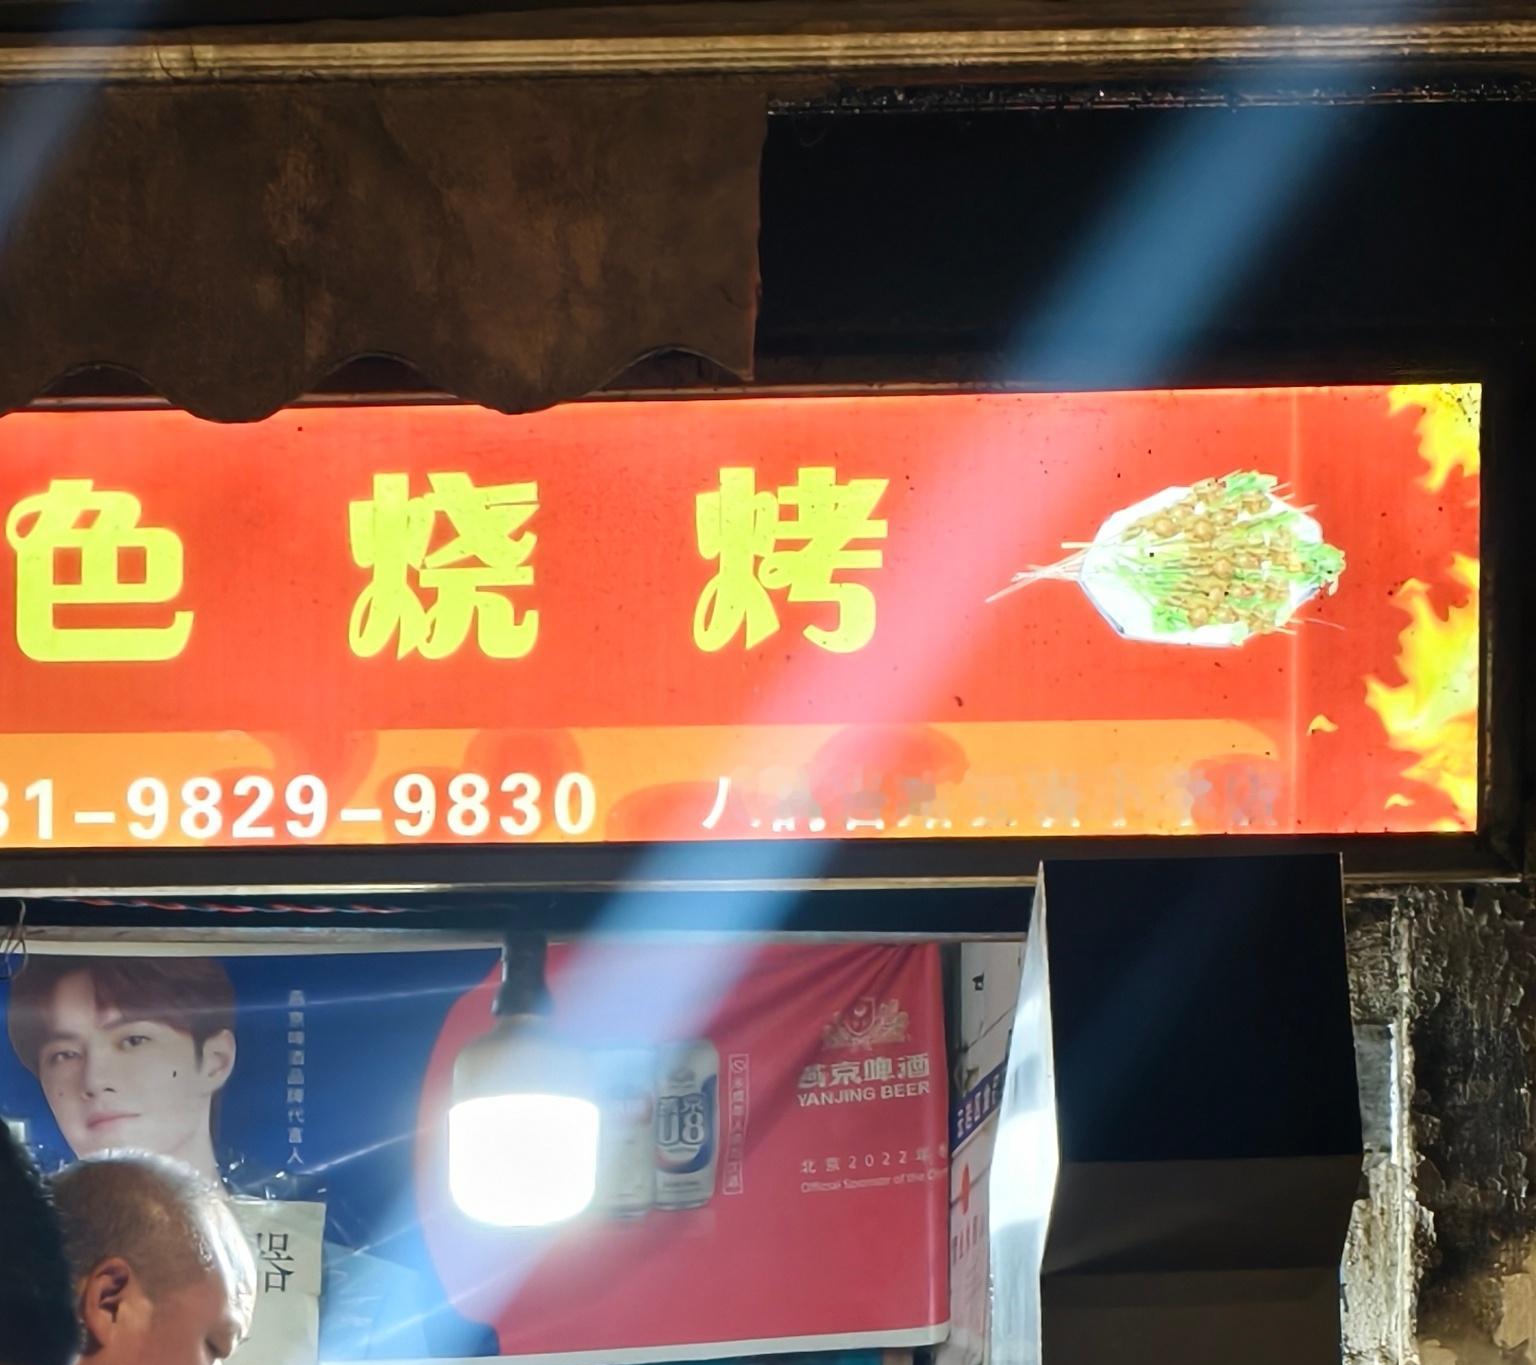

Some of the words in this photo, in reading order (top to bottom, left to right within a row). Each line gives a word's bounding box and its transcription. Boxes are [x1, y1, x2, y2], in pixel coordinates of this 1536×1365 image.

[797, 1052, 930, 1089] 燕京啤酒
[797, 1087, 876, 1107] YANJING
[880, 1080, 930, 1100] BEER
